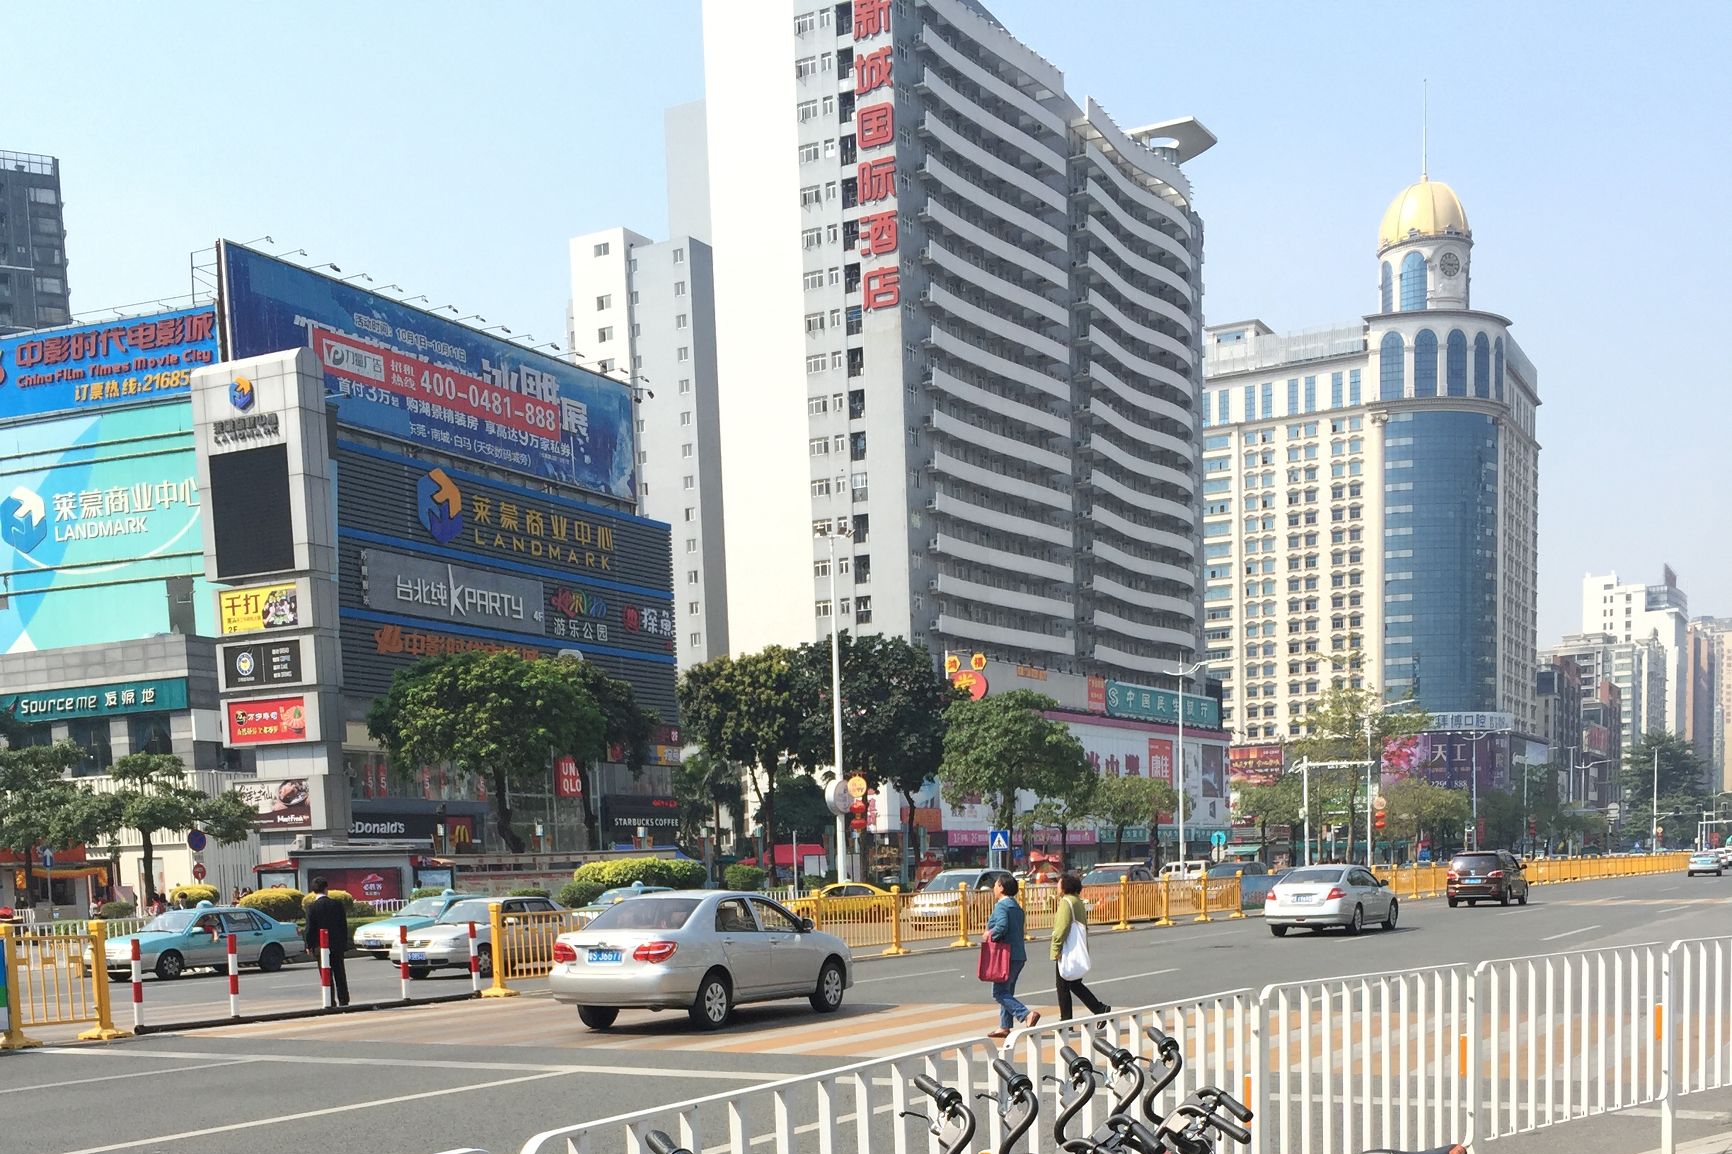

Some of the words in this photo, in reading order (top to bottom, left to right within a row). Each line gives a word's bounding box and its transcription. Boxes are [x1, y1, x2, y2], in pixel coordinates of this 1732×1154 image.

[853, 0, 900, 311] 新城国际酒店
[15, 310, 214, 367] 中影时代电影城
[16, 370, 56, 388] China
[56, 365, 84, 382] Film
[88, 361, 130, 378] Times
[134, 354, 178, 371] Movie
[182, 349, 212, 364] City
[420, 369, 557, 432] 400-0481-888
[53, 477, 200, 521] 莱蒙商业中心
[55, 516, 149, 542] LANDMARK
[472, 495, 614, 551] 莱蒙商业中心
[475, 529, 611, 571] LANDMARK
[553, 617, 608, 642] 游乐公园
[21, 697, 74, 714] Source
[562, 778, 582, 794] QLO
[347, 821, 405, 834] cDonald's
[615, 817, 655, 827] STARBUCKS
[655, 817, 679, 827] COFFEE
